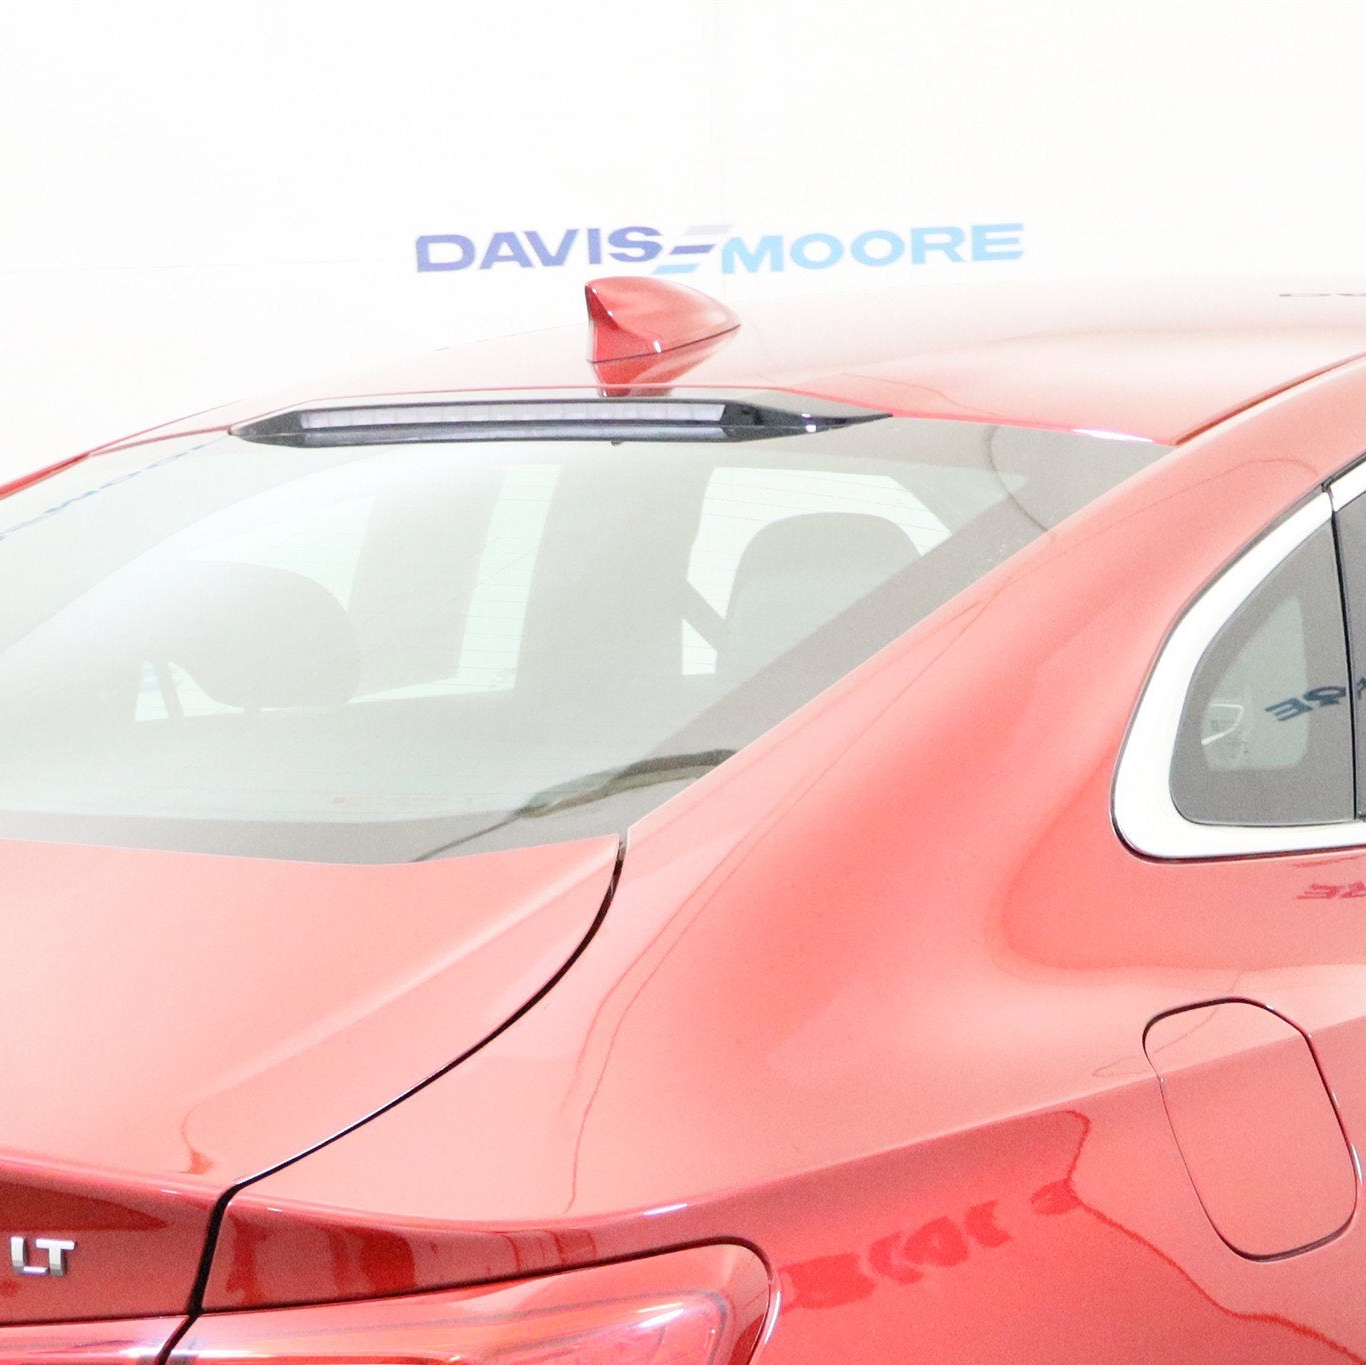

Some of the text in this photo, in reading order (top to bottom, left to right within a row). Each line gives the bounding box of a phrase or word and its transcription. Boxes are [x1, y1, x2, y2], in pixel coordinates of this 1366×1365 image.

[415, 223, 1024, 274] DAVIS MOORE
[10, 1236, 76, 1277] LT
